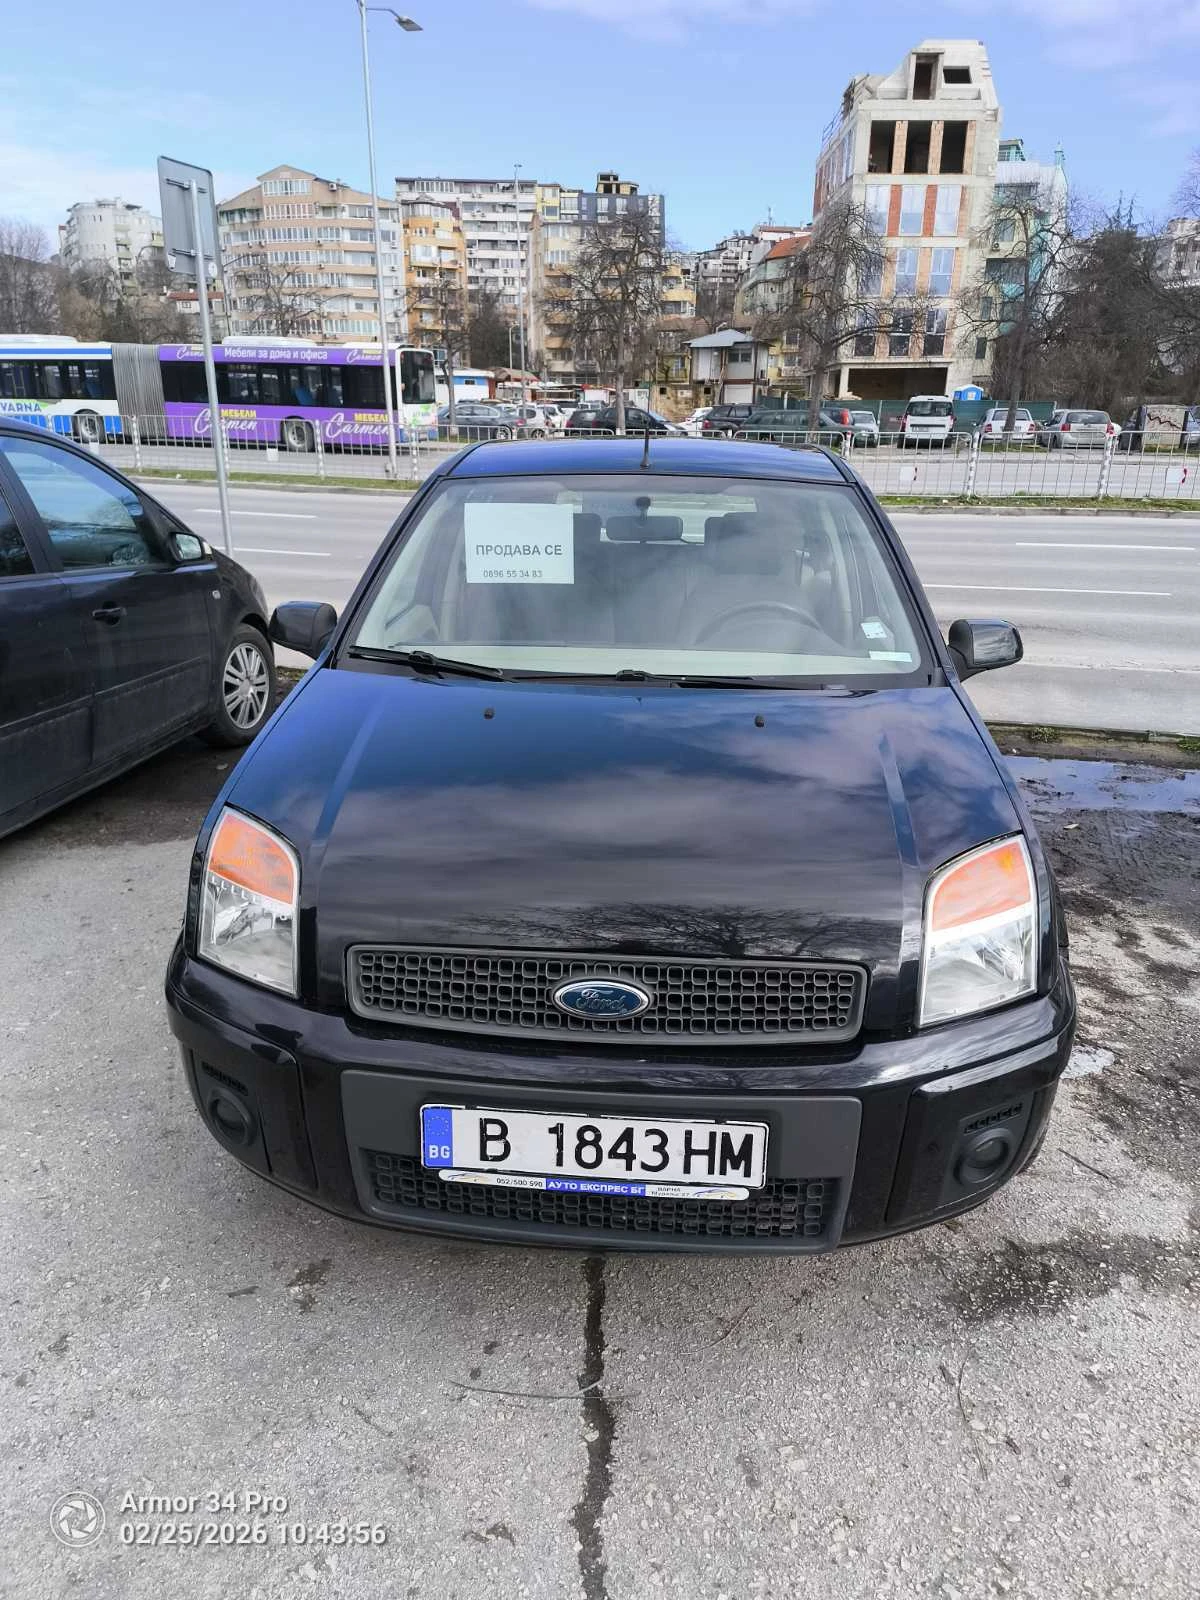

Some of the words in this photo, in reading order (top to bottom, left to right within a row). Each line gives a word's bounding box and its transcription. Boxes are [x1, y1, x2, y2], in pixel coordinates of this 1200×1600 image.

[224, 347, 257, 359] Мебели
[258, 349, 268, 358] за
[269, 350, 291, 360] дома
[292, 351, 299, 359] и
[300, 350, 328, 361] офиса
[0, 402, 41, 412] VARNA
[221, 409, 257, 418] МЕБЕЛИ
[475, 544, 541, 557] ПРОДАВА
[544, 544, 563, 556] СЕ
[483, 570, 504, 578] 0896
[506, 570, 517, 578] 55
[519, 570, 530, 578] 34
[532, 570, 543, 578] 83
[576, 988, 628, 1010] Ford
[429, 1145, 450, 1159] BG
[479, 1118, 511, 1162] B
[548, 1123, 670, 1172] 1843
[682, 1130, 754, 1178] HM
[548, 1181, 578, 1191] АУТО
[580, 1184, 628, 1193] ЕКСПРЕС
[631, 1186, 645, 1194] БГ
